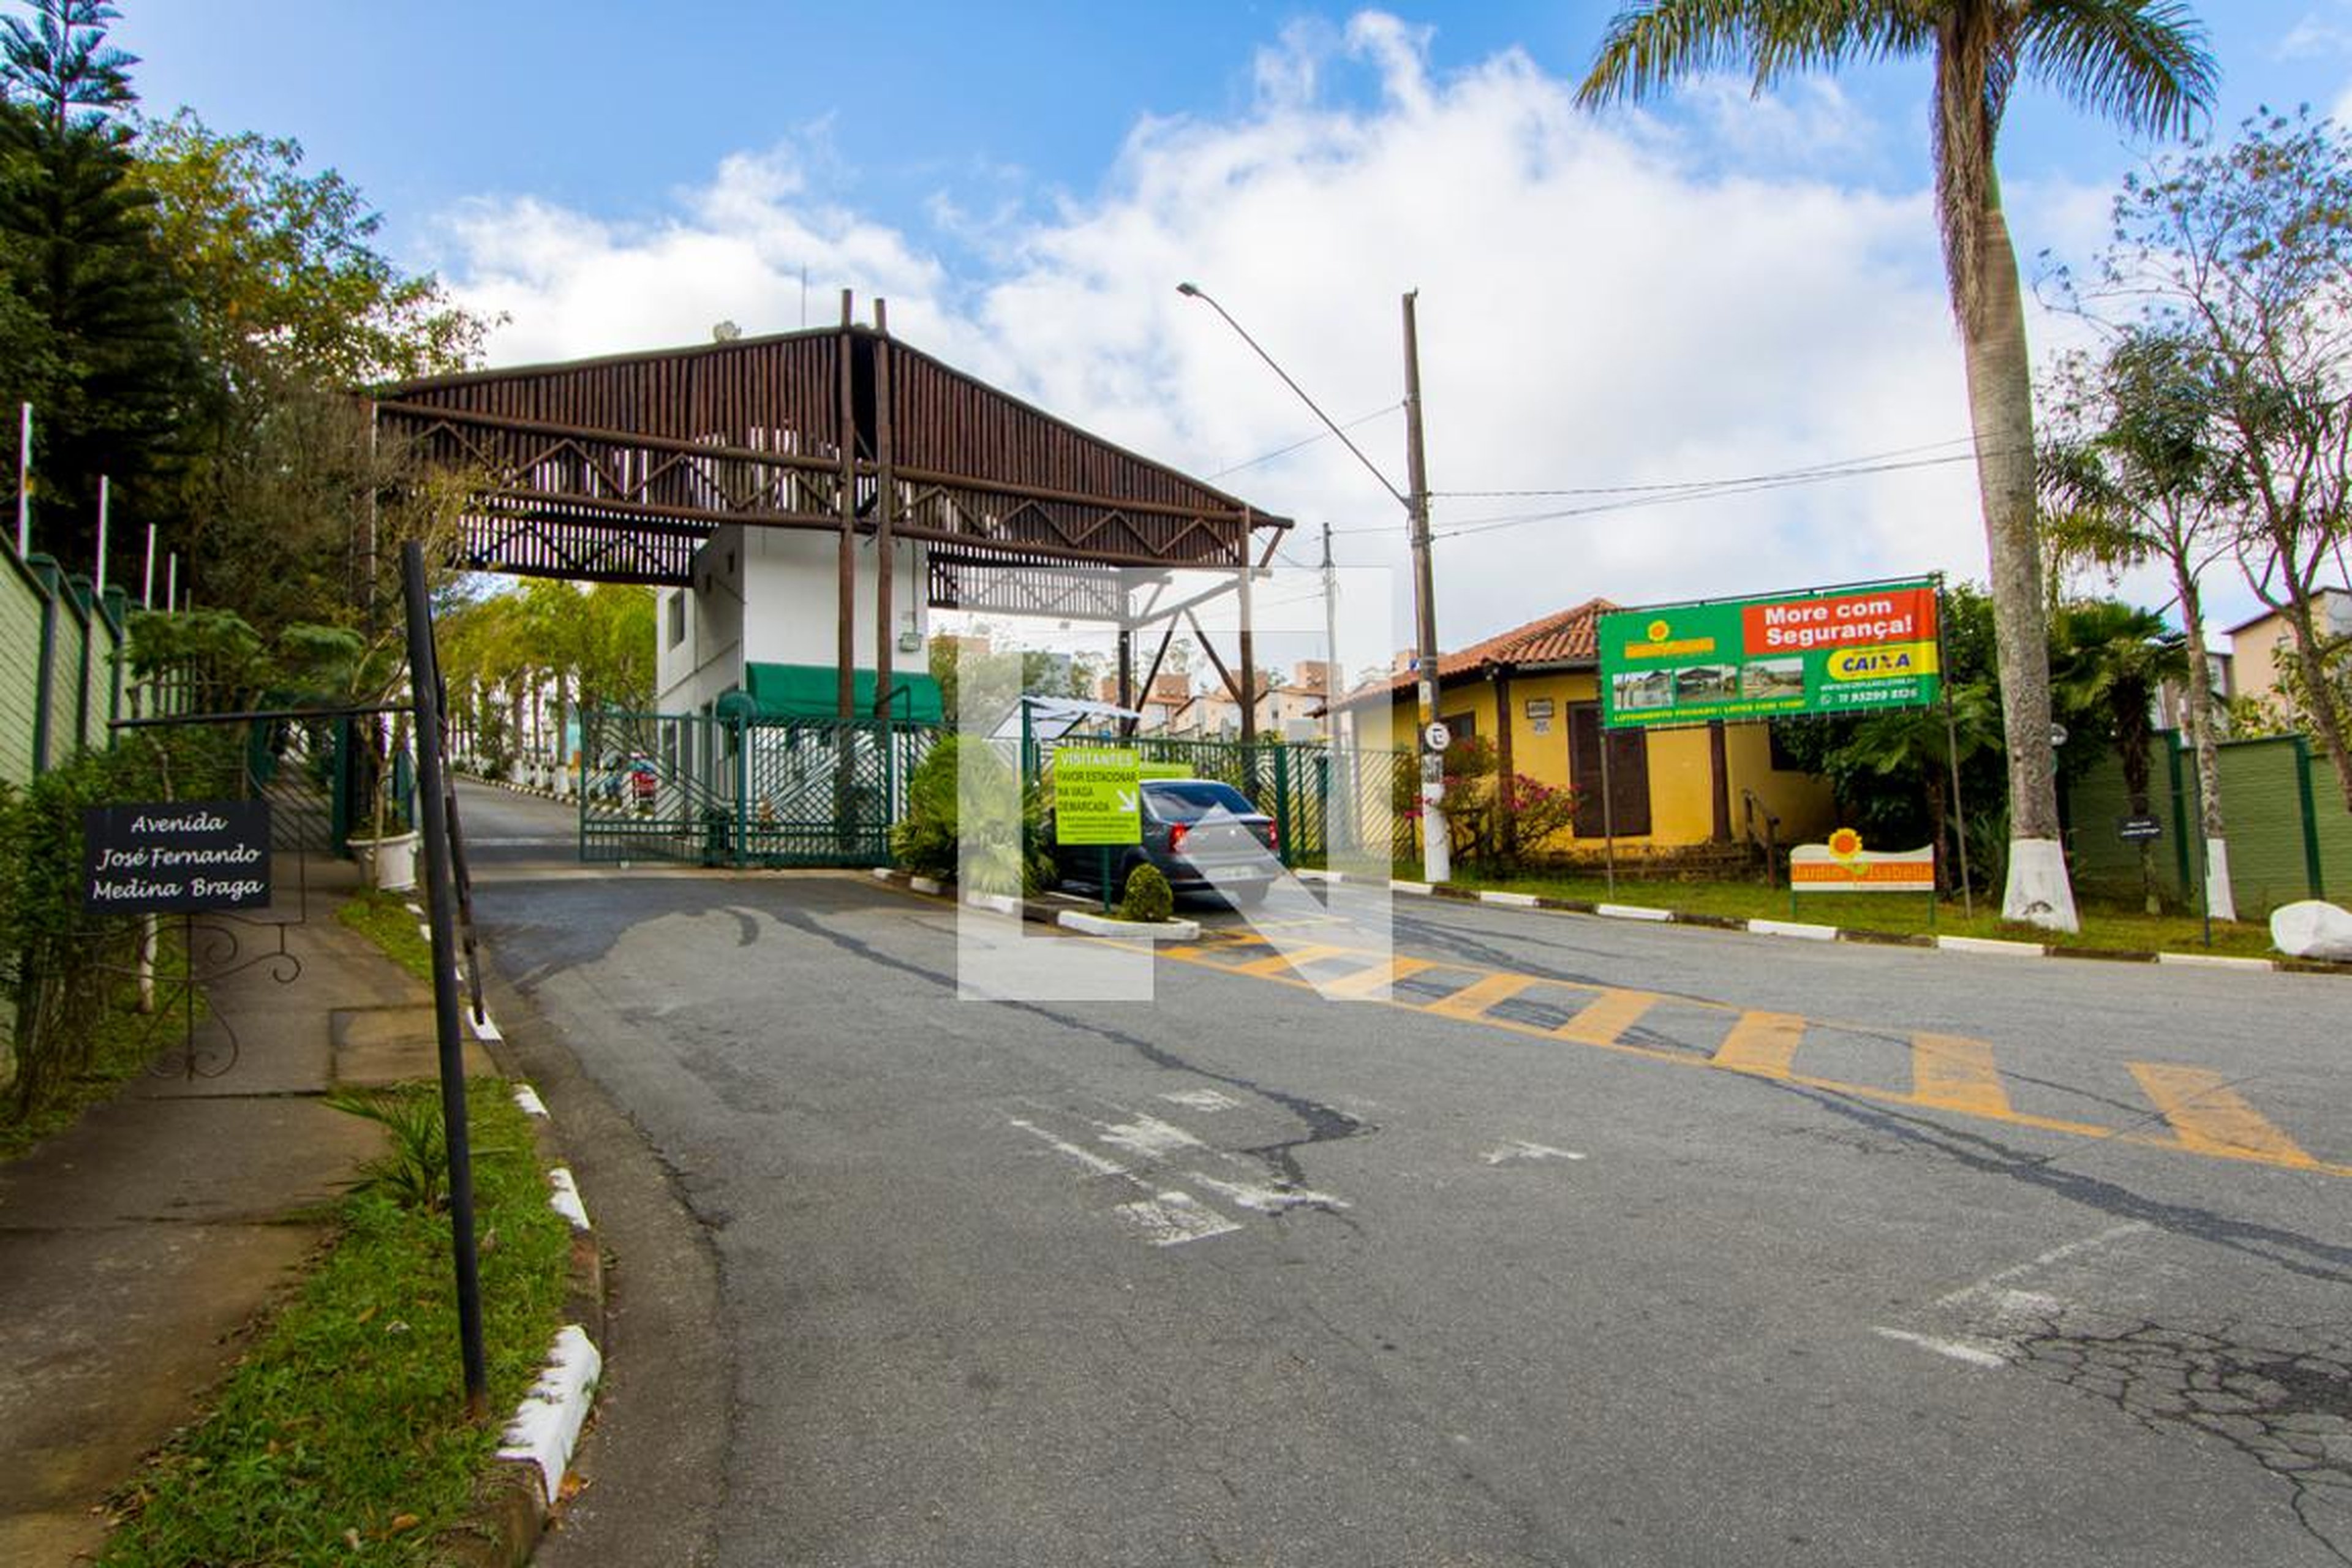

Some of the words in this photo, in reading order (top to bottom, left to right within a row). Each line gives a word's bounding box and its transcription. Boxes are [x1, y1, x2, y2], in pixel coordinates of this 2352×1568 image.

[1765, 606, 1829, 625] More
[1836, 600, 1892, 618] com
[1766, 614, 1912, 647] Segurança!
[1842, 652, 1910, 672] CAIXA
[131, 812, 229, 833] Avenida
[96, 849, 148, 871] José
[151, 843, 262, 868] Fernando
[92, 878, 183, 900] Medina
[190, 878, 264, 901] Braga
